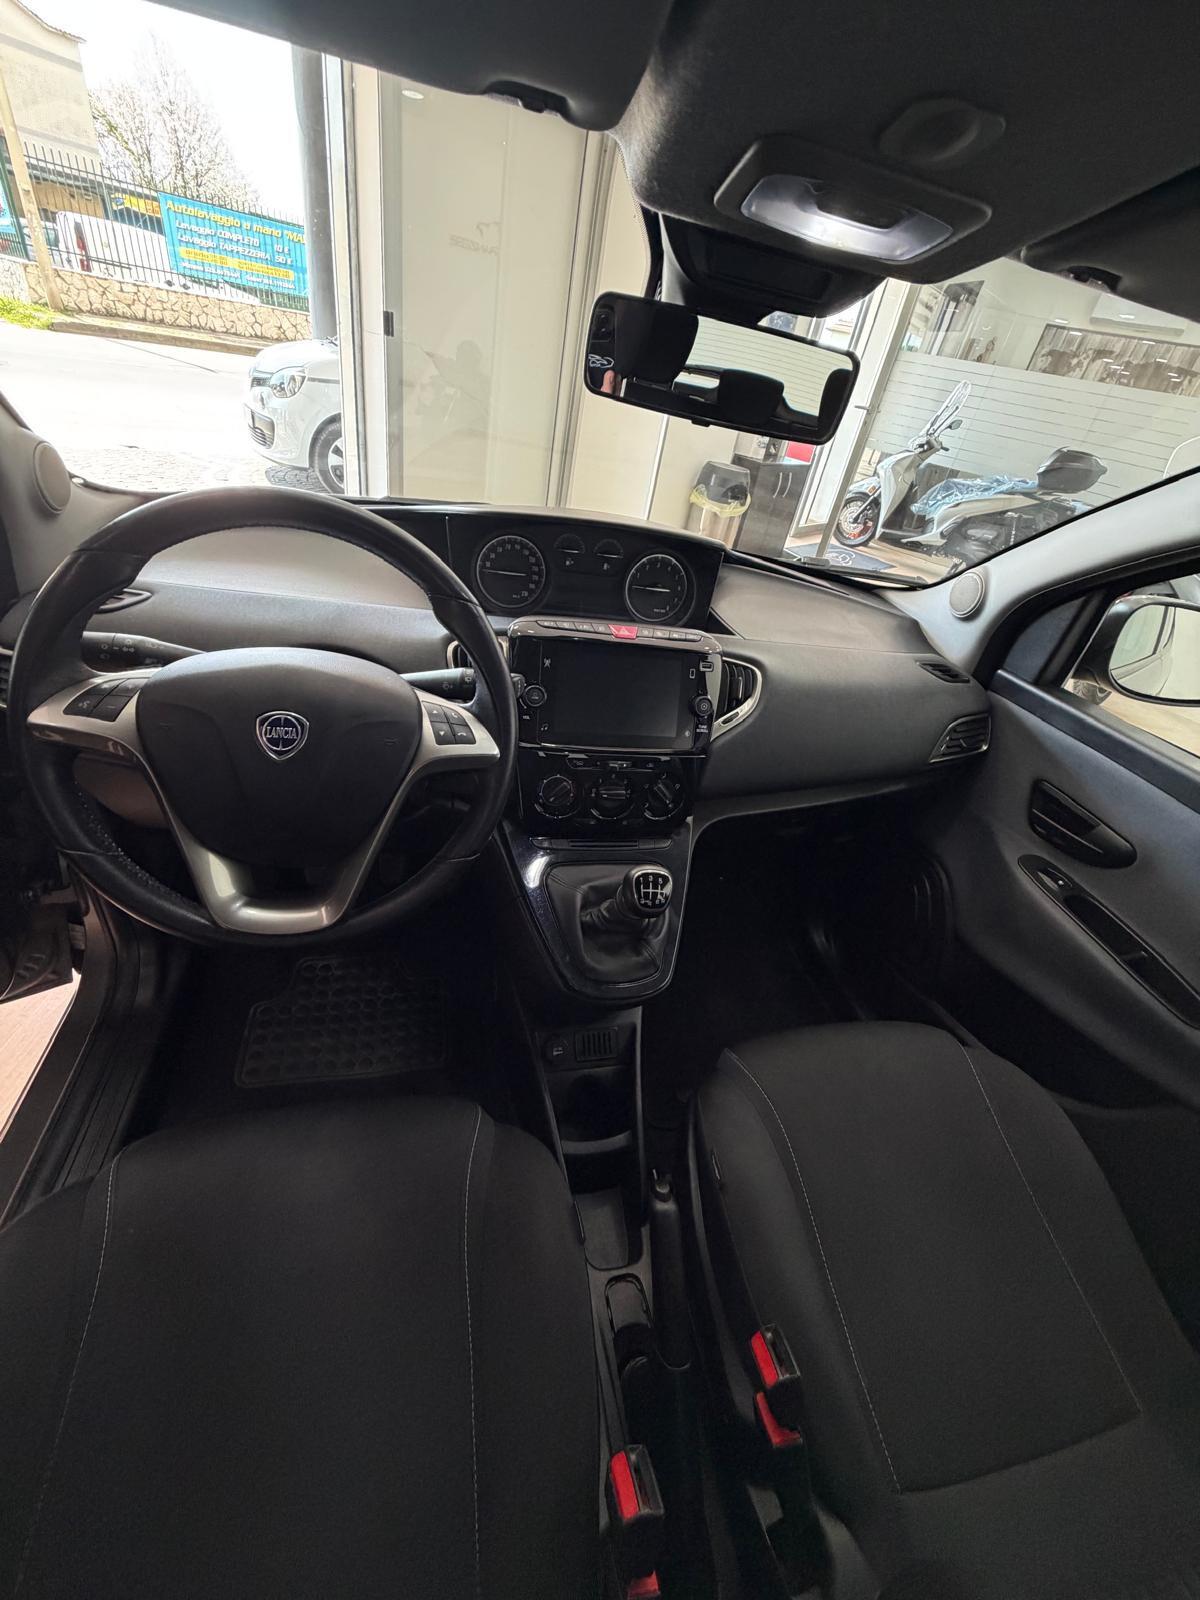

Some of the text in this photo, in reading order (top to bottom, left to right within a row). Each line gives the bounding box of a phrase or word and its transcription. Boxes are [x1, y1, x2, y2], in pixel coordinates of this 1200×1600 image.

[166, 201, 241, 227] Autolavaggio
[254, 224, 282, 238] mano
[176, 220, 216, 236] Lavaggio
[217, 228, 260, 247] COMPLETO
[177, 233, 217, 249] Lavaggio
[219, 241, 271, 261] TAPPEZZERIA
[266, 726, 298, 739] LANCIA
